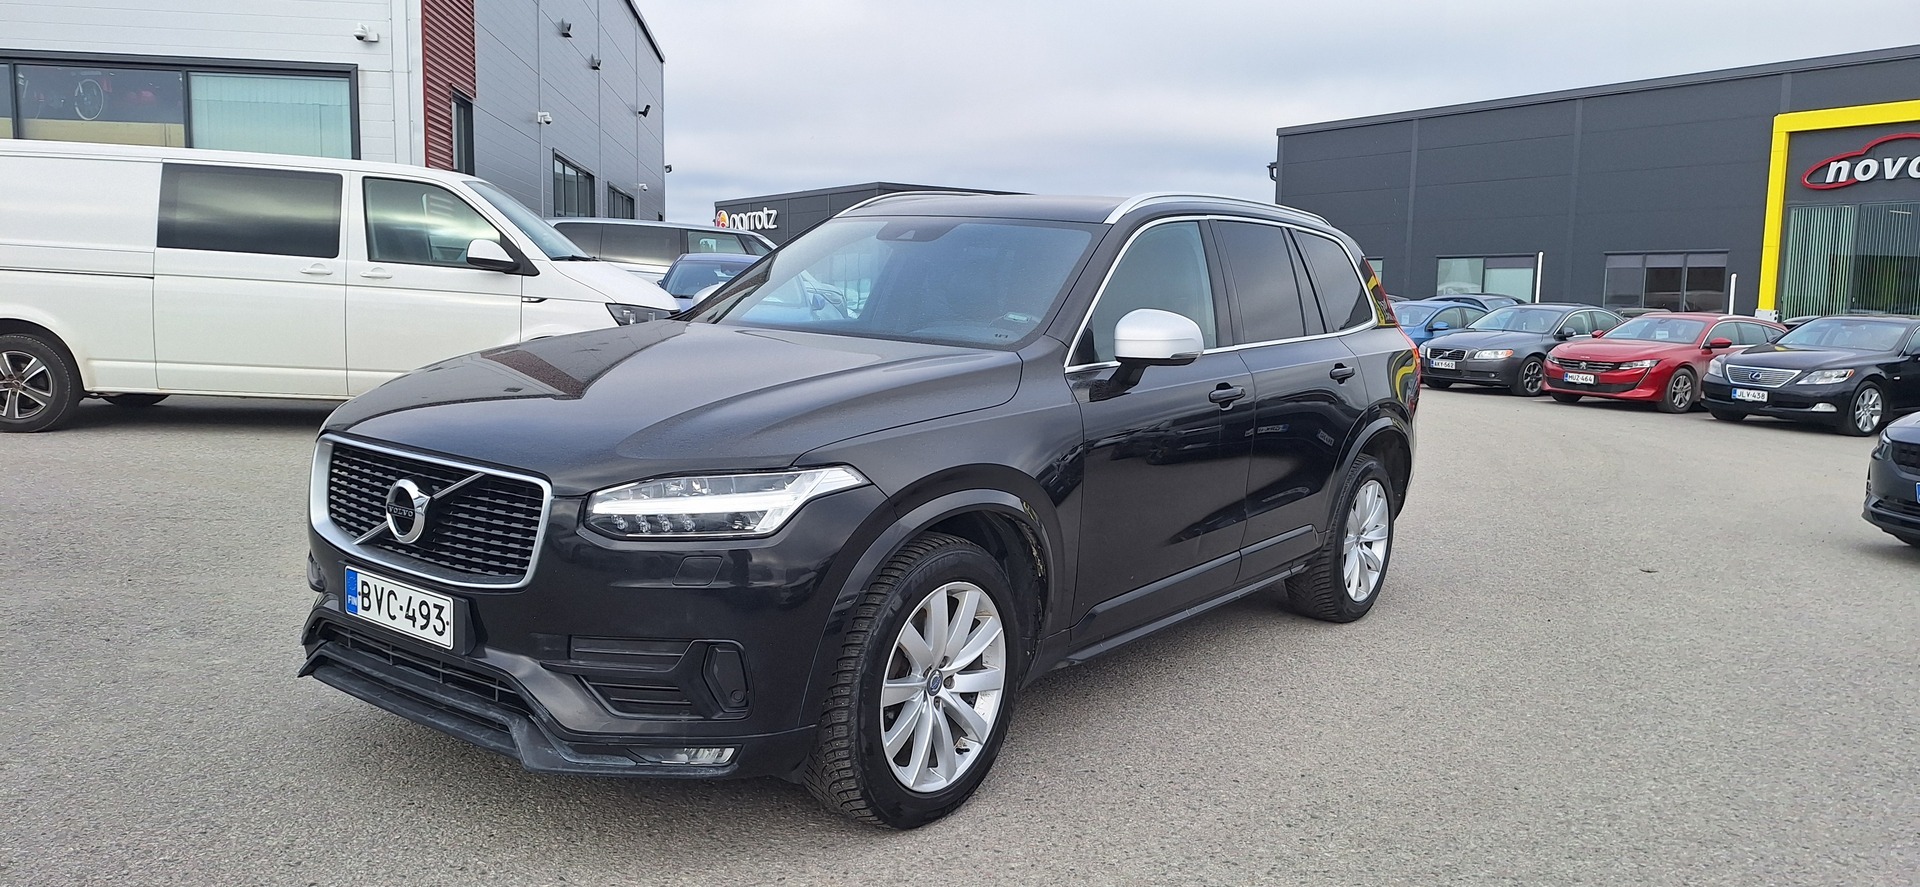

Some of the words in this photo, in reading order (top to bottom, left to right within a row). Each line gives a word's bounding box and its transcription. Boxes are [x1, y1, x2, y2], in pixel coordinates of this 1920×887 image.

[388, 505, 414, 517] VOLVO
[347, 594, 358, 606] FIN
[360, 579, 446, 637] BVC-493
